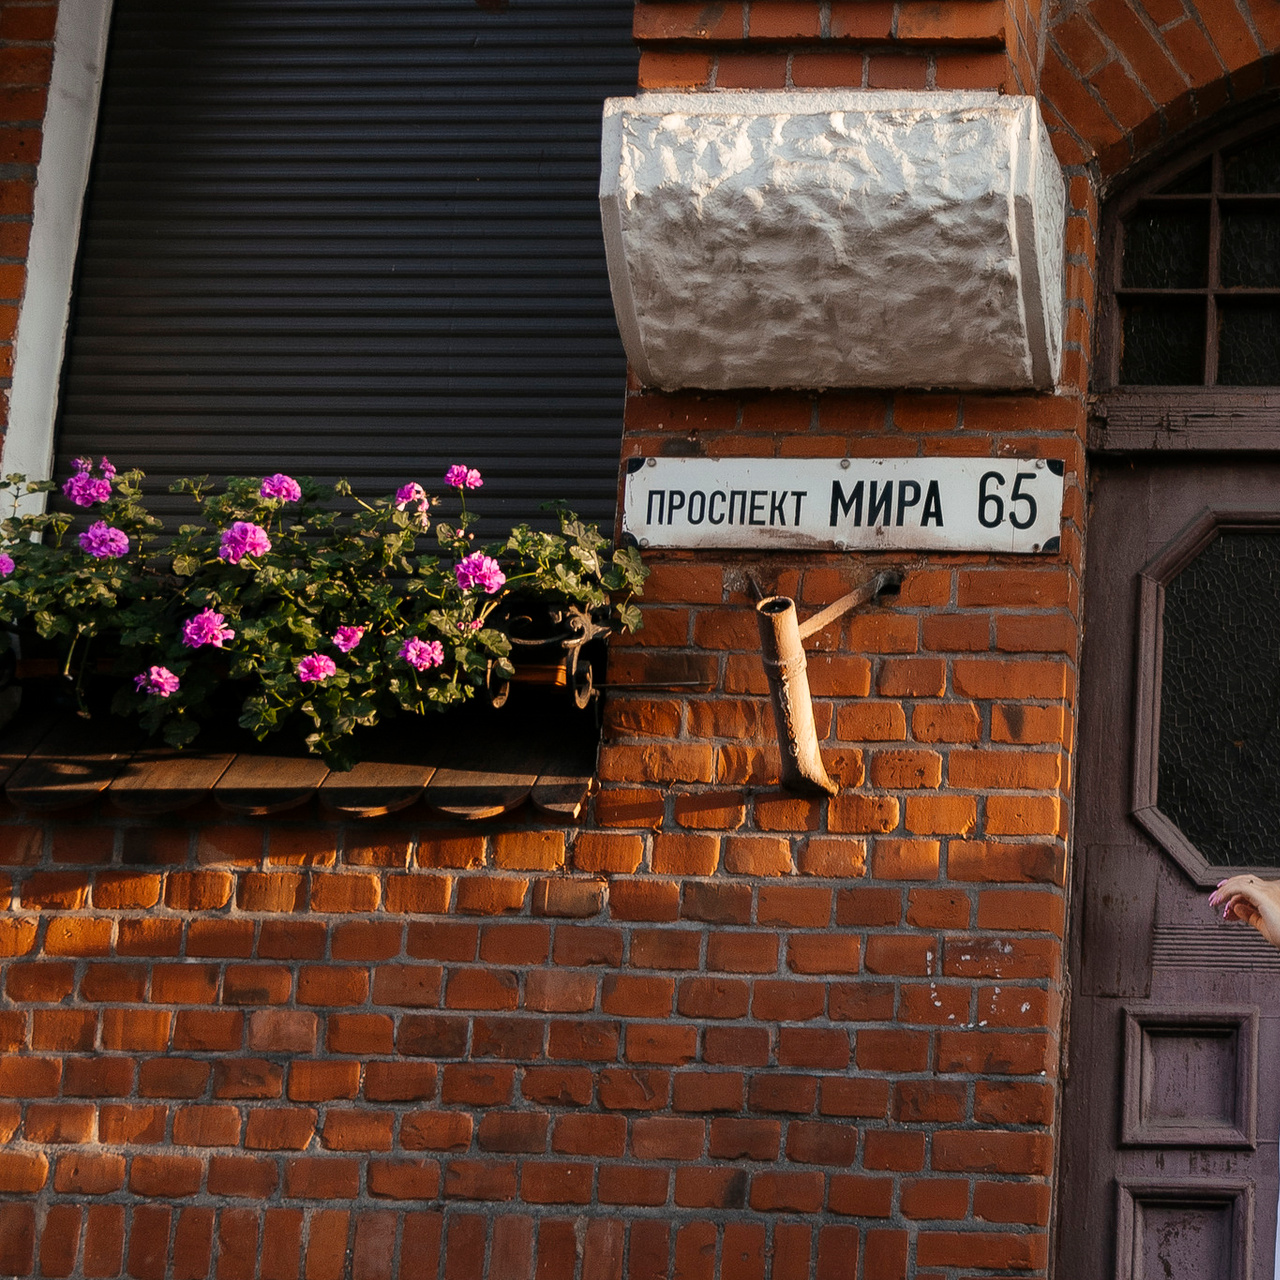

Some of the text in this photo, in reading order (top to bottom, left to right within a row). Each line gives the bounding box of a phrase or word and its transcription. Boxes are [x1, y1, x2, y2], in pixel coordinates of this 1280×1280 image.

[645, 470, 1037, 529] ПРОСПЕКТ МИРА 65
